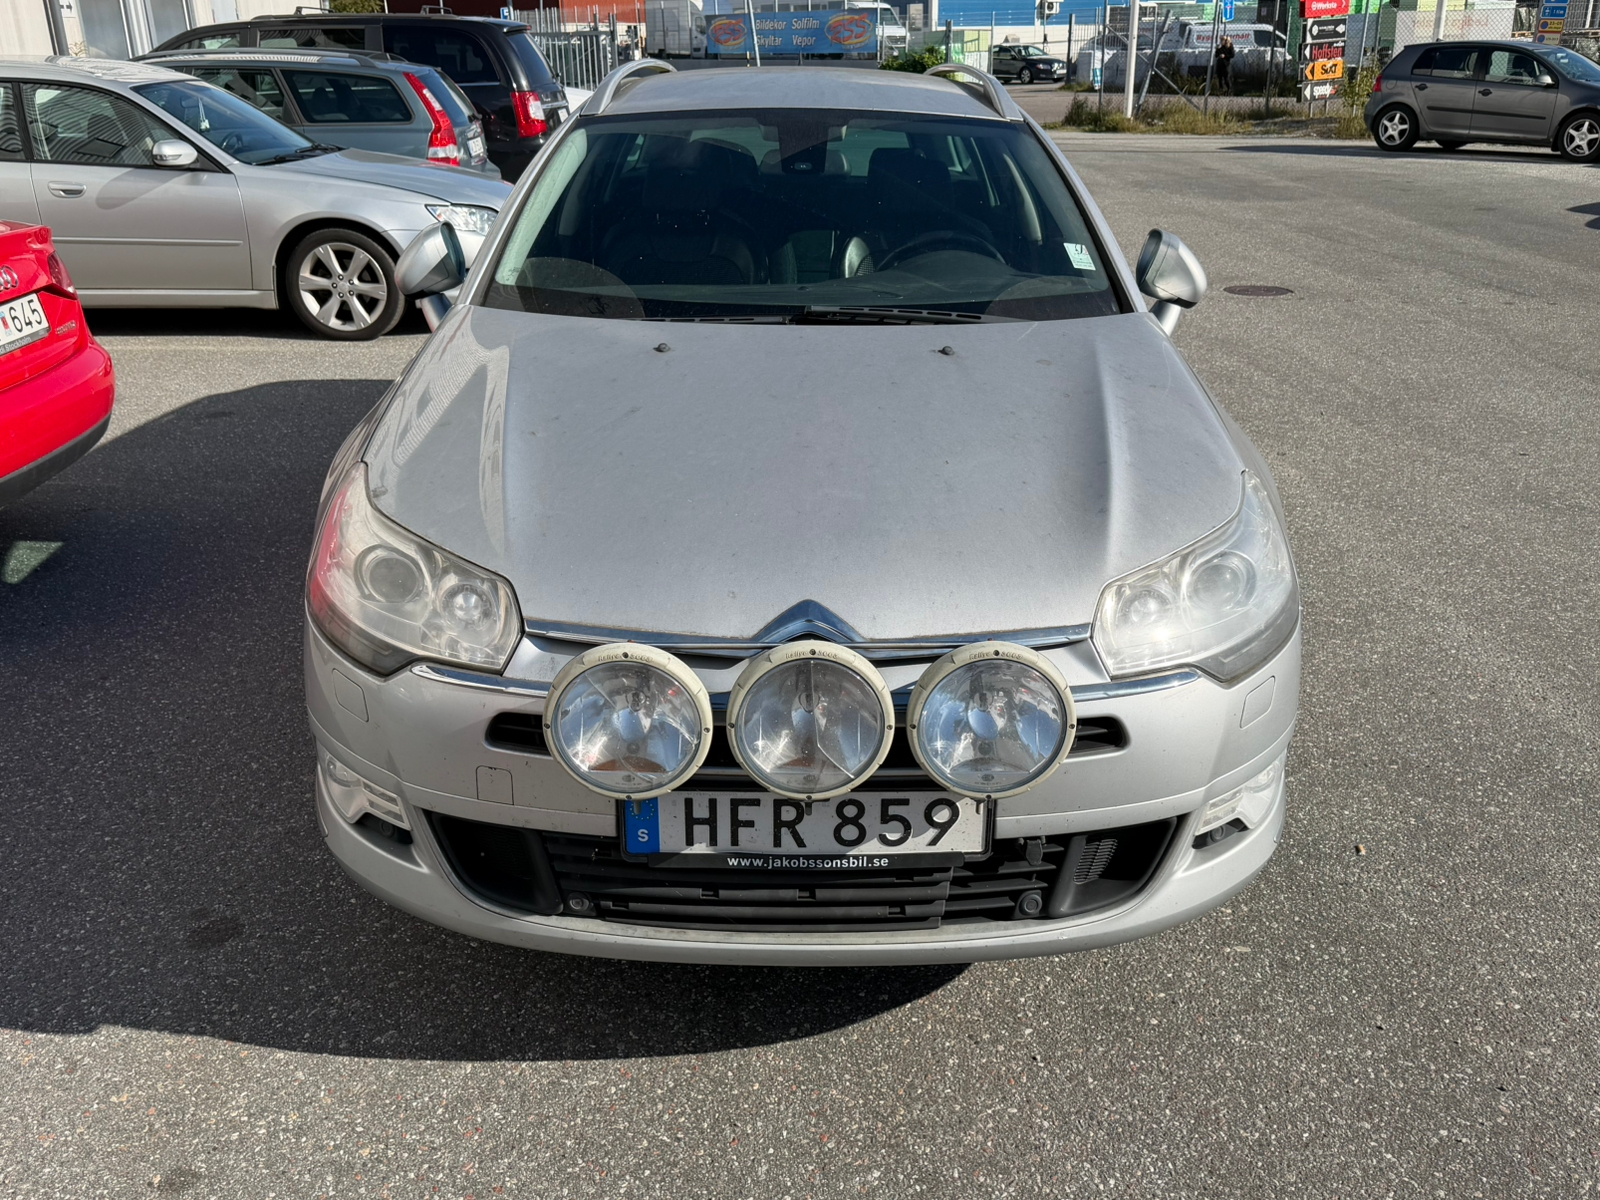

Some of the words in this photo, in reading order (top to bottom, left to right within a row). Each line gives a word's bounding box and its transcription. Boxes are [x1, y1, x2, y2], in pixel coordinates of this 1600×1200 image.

[755, 17, 787, 30] Bildekor
[792, 17, 820, 30] Solfilm
[756, 35, 783, 48] Skyltar
[792, 35, 816, 47] Vepor
[9, 299, 42, 333] 645
[684, 797, 807, 848] HFR
[832, 796, 960, 848] 859
[637, 828, 650, 842] S
[727, 854, 889, 870] www.jakobssonsbil.se
